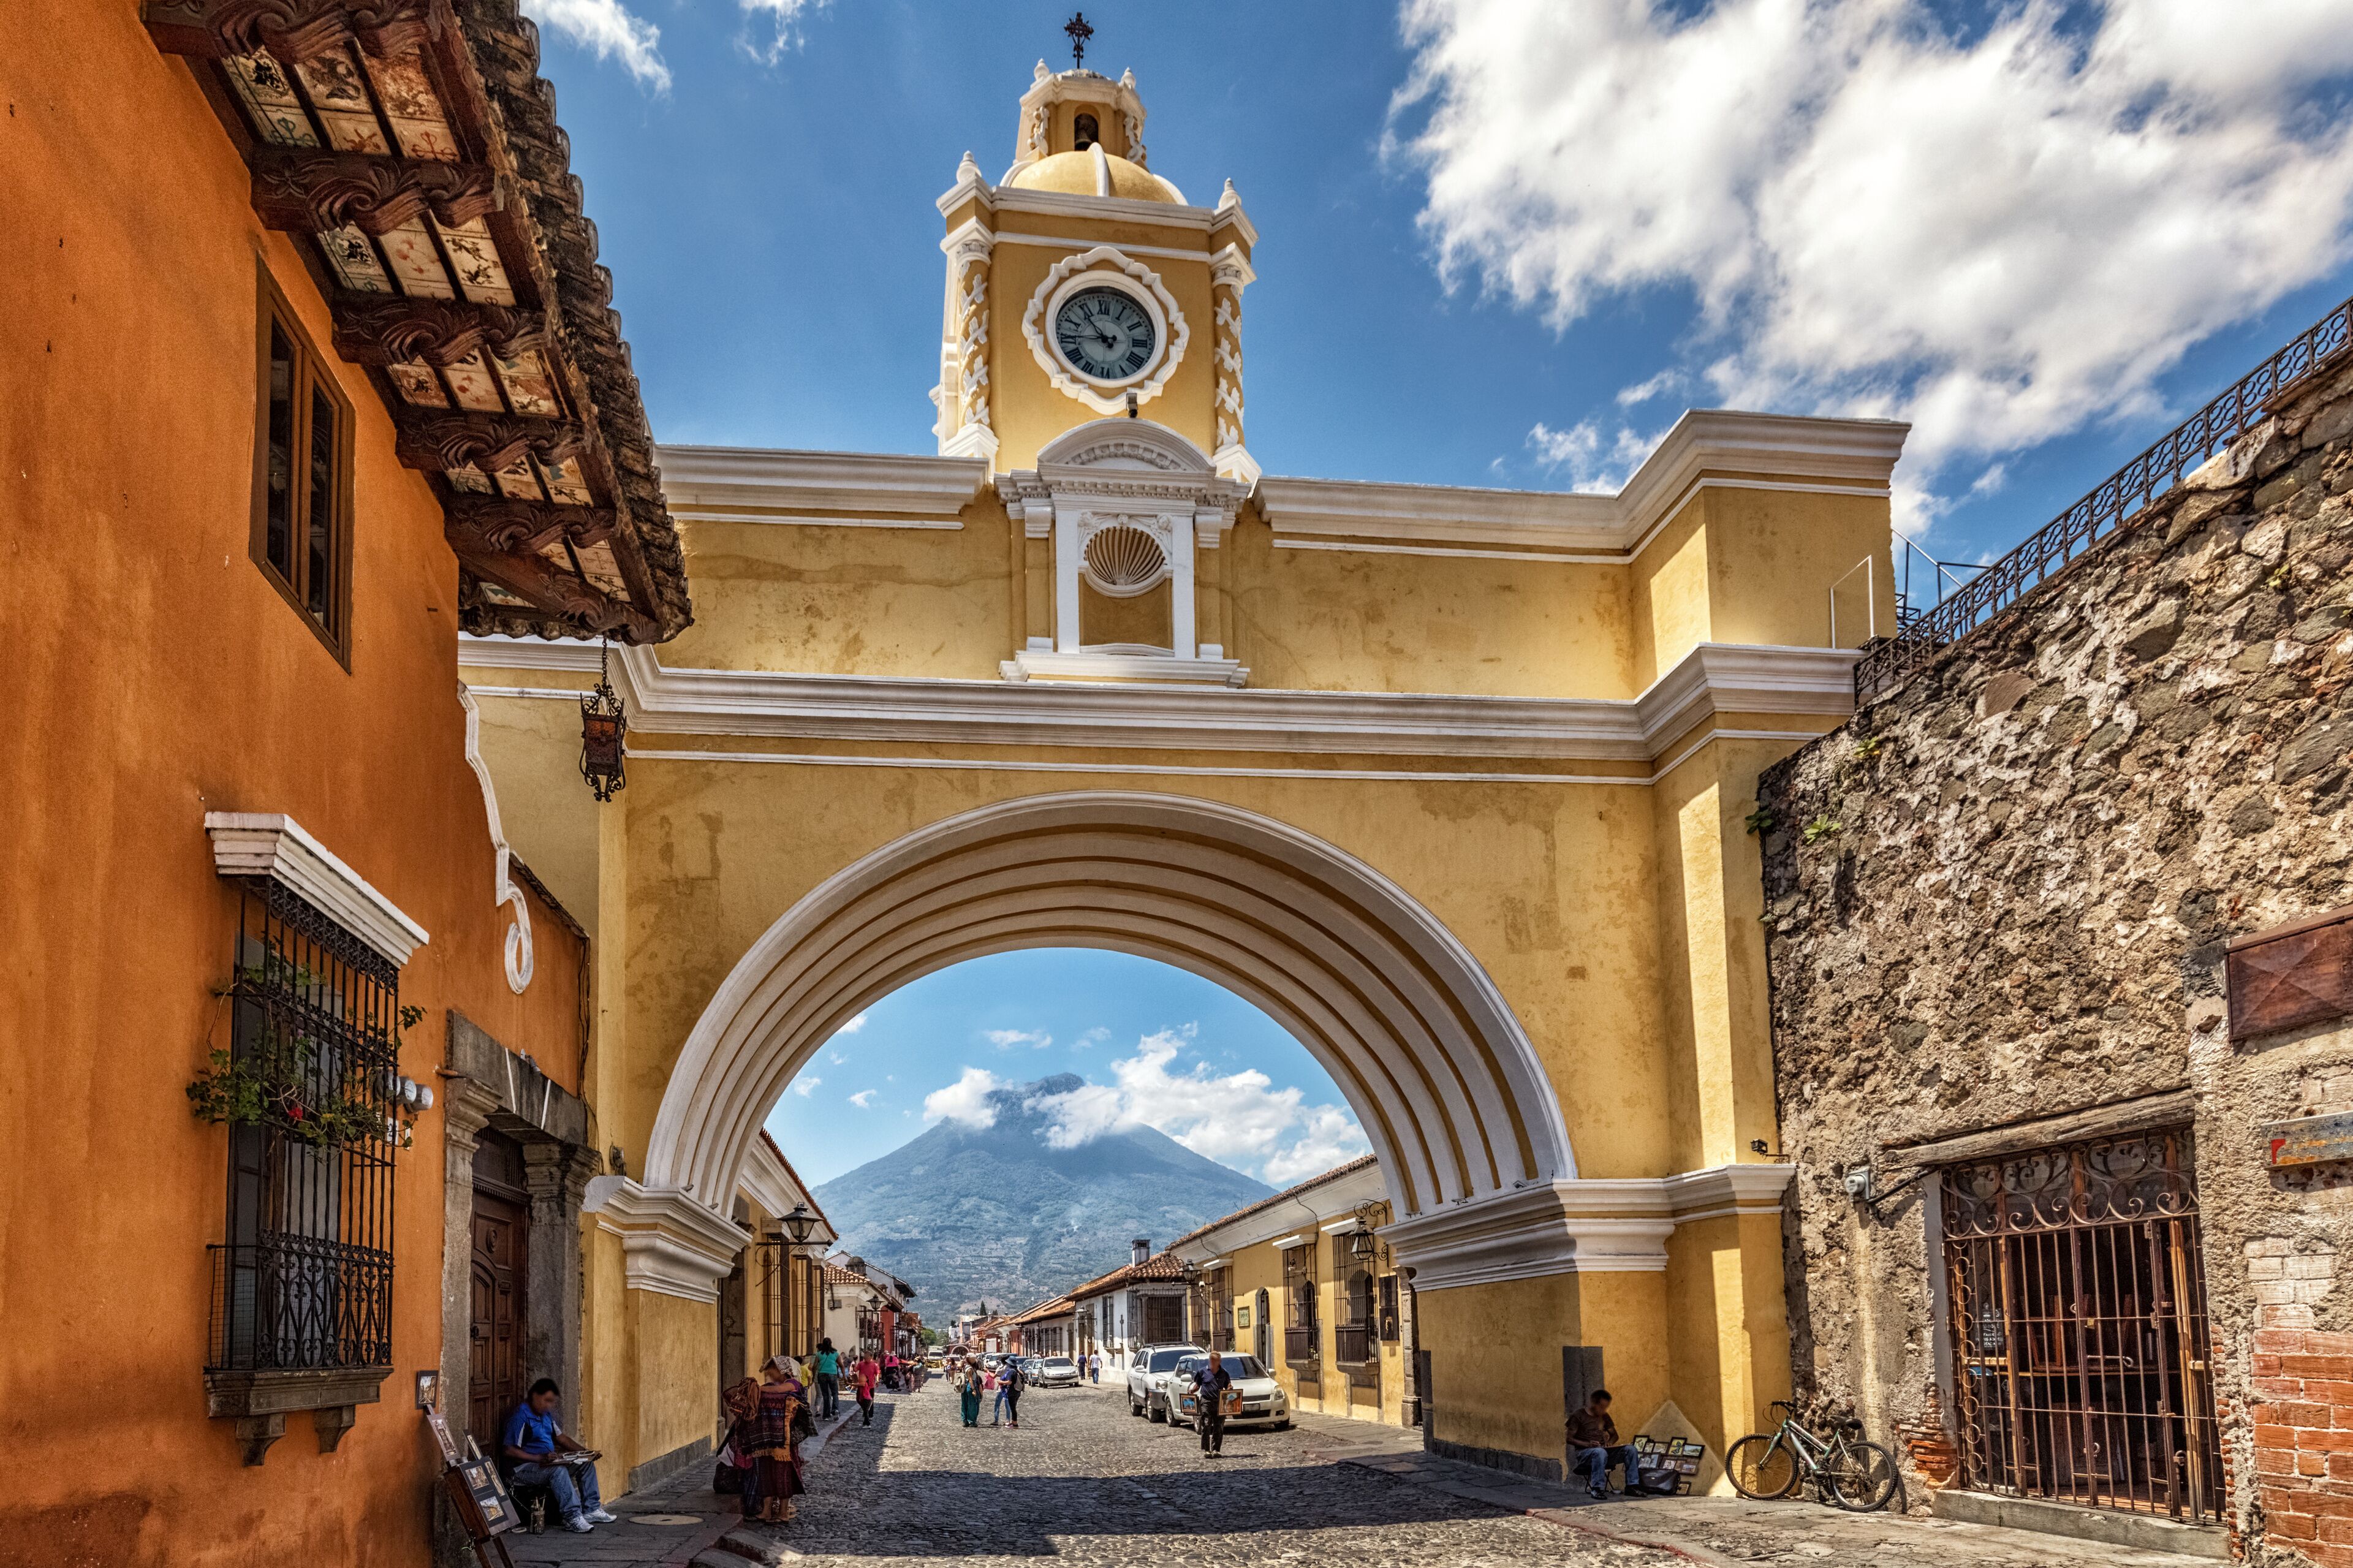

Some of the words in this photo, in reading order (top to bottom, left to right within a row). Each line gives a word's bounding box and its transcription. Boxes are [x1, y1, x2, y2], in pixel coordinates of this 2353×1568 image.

[1078, 303, 1094, 320] XI
[1097, 300, 1110, 316] XII
[1115, 306, 1127, 320] I
[1064, 315, 1081, 328] X
[1127, 320, 1143, 331] II
[1132, 338, 1148, 349] III
